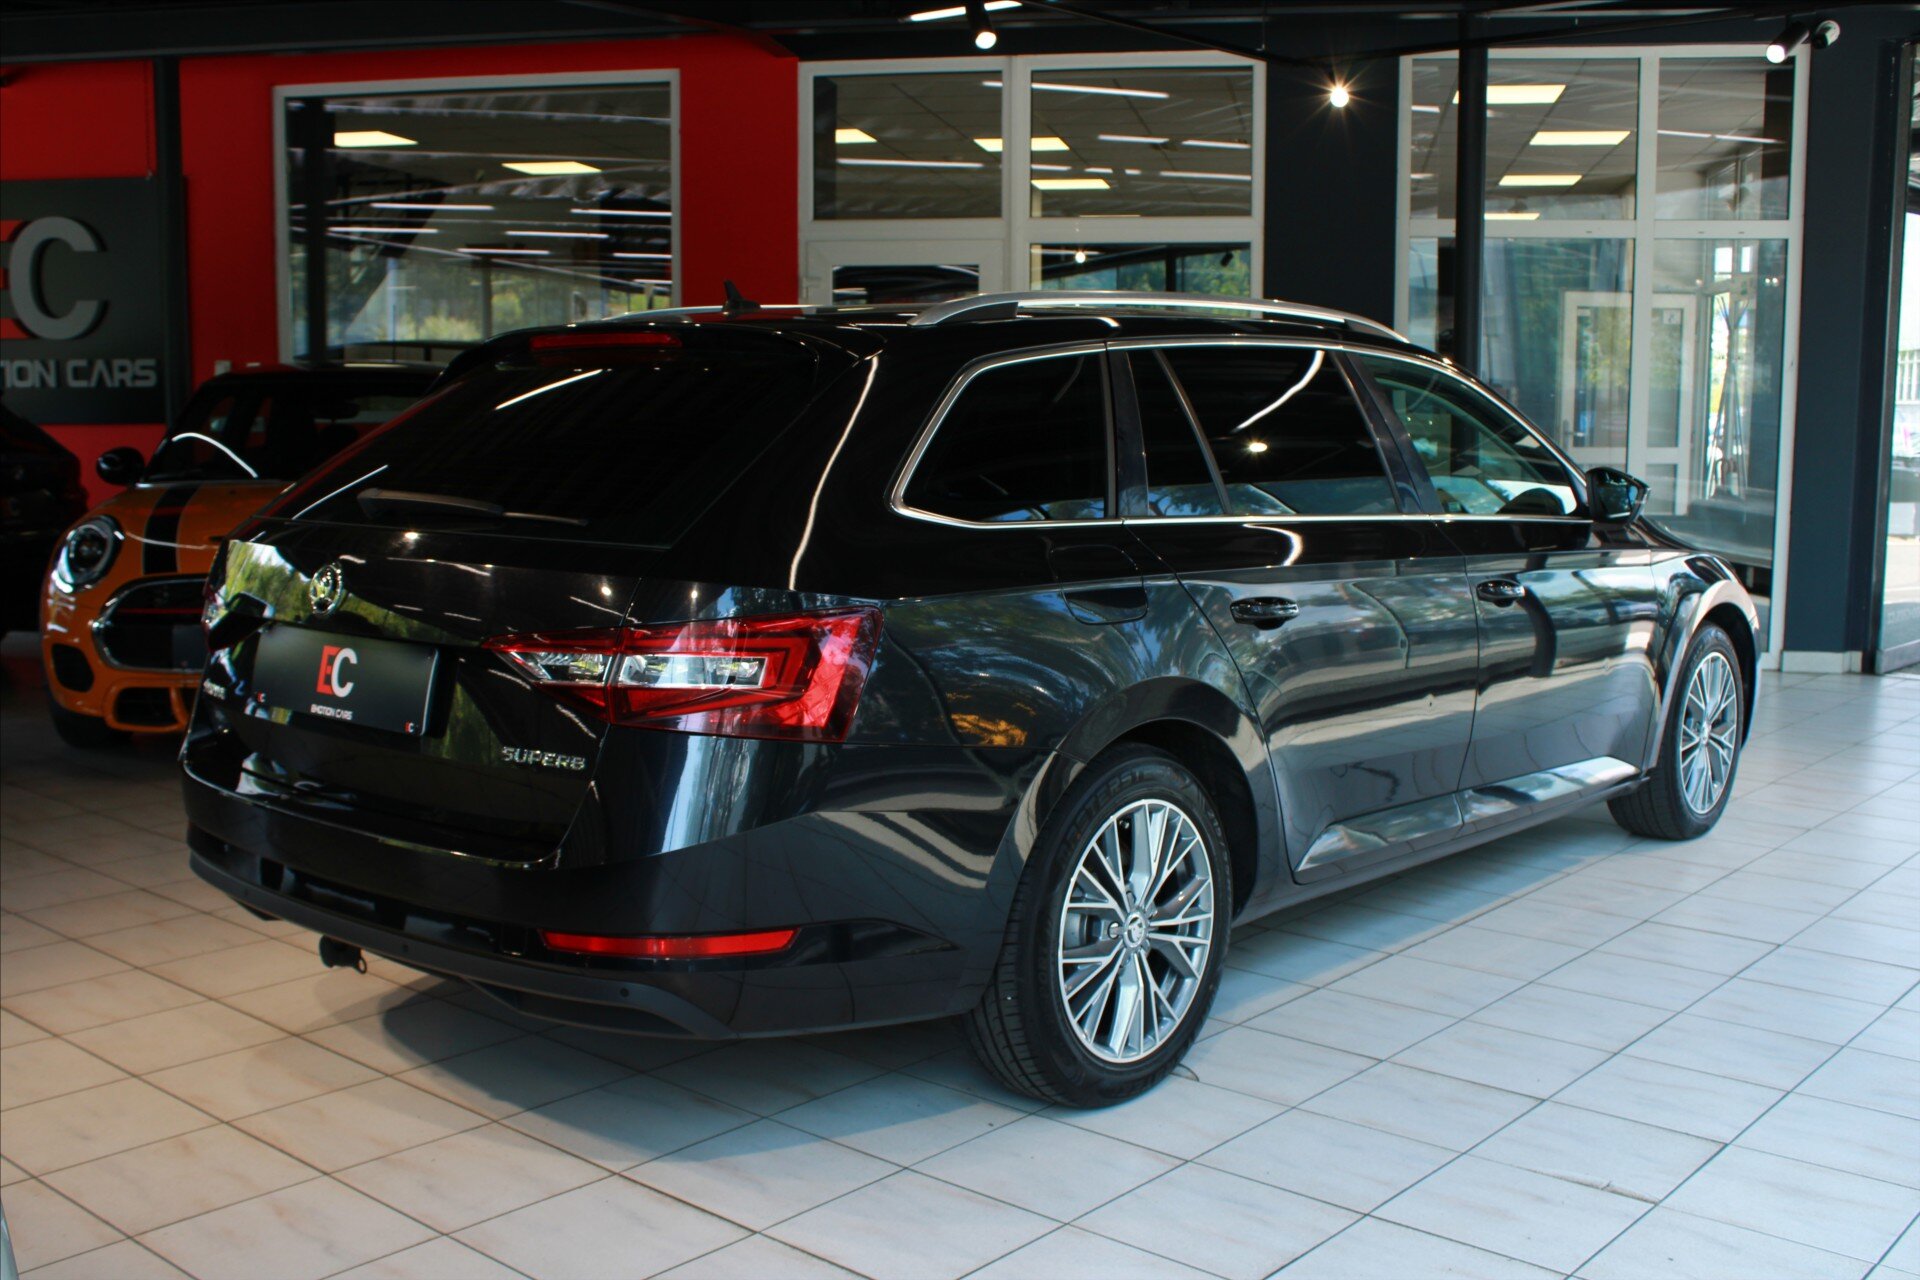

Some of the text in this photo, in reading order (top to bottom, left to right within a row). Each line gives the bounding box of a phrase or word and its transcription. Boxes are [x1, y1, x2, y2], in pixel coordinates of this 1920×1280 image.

[66, 358, 156, 387] CARS
[316, 645, 358, 698] EC
[335, 708, 353, 720] CARS
[502, 746, 585, 770] SUPERB
